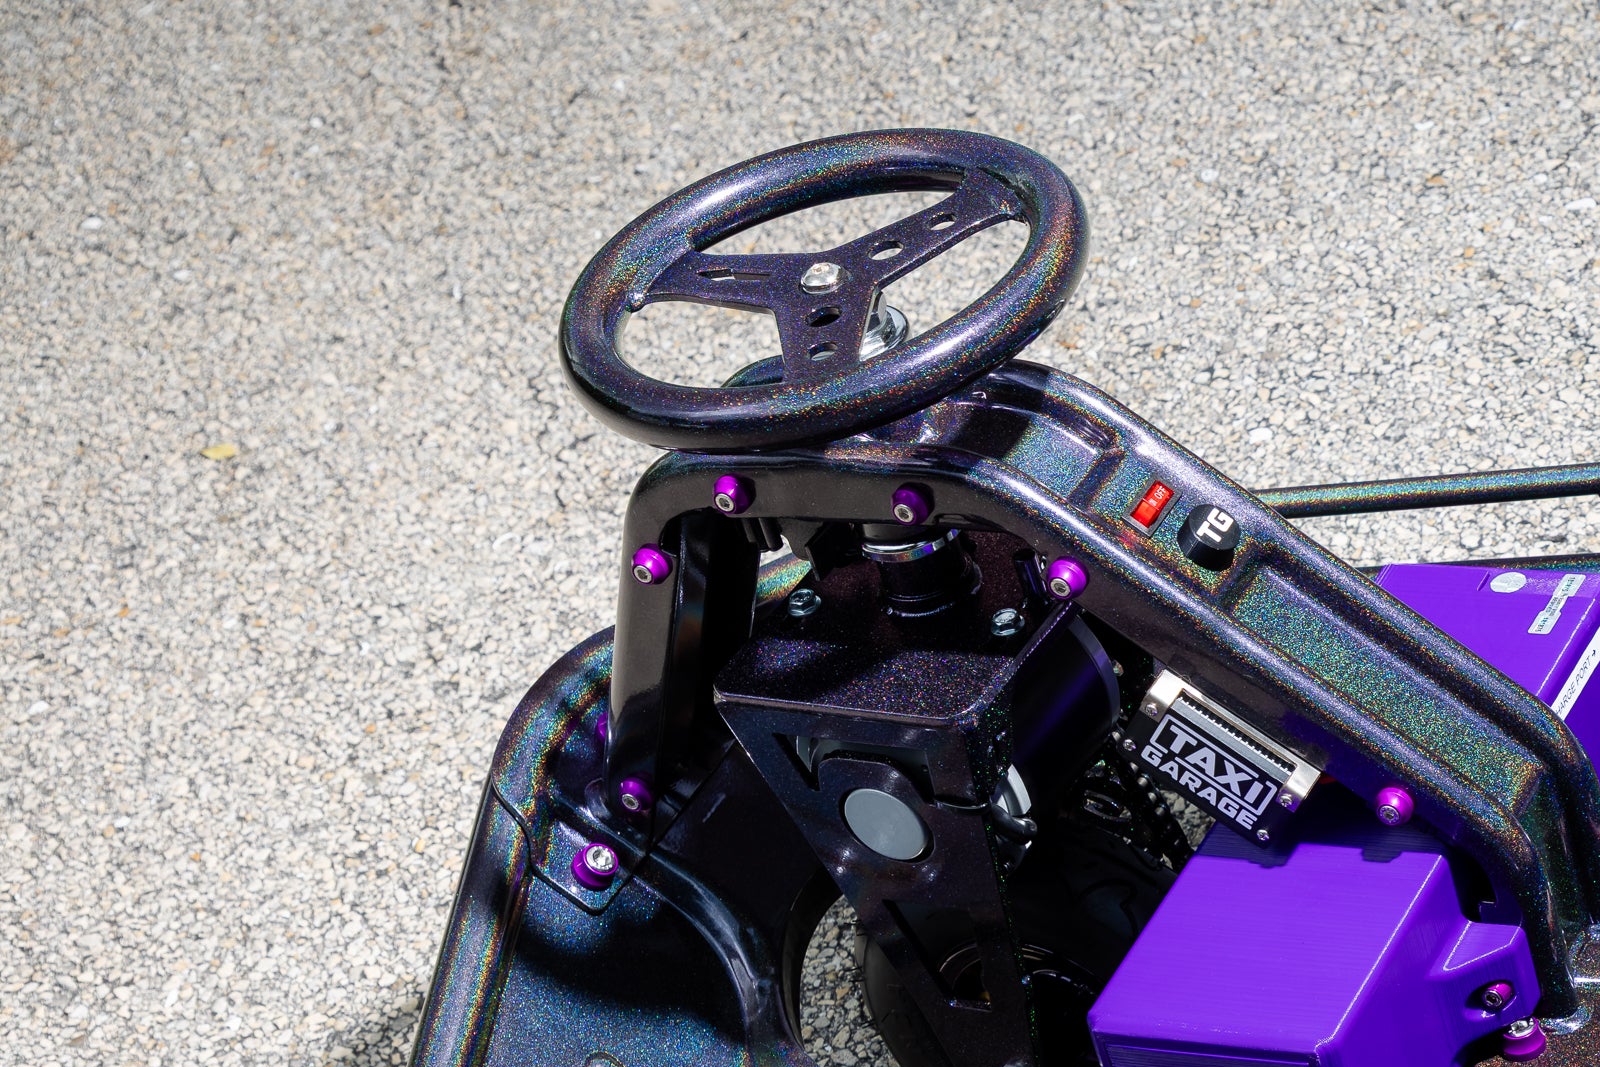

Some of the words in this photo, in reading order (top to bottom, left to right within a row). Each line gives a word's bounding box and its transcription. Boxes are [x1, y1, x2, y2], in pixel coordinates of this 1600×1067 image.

[1154, 486, 1166, 499] OFF
[1196, 508, 1234, 542] TG
[1556, 681, 1576, 715] HARGE
[1576, 655, 1590, 685] PORT
[1140, 744, 1258, 830] GARAGE
[1169, 724, 1264, 804] TAXI
